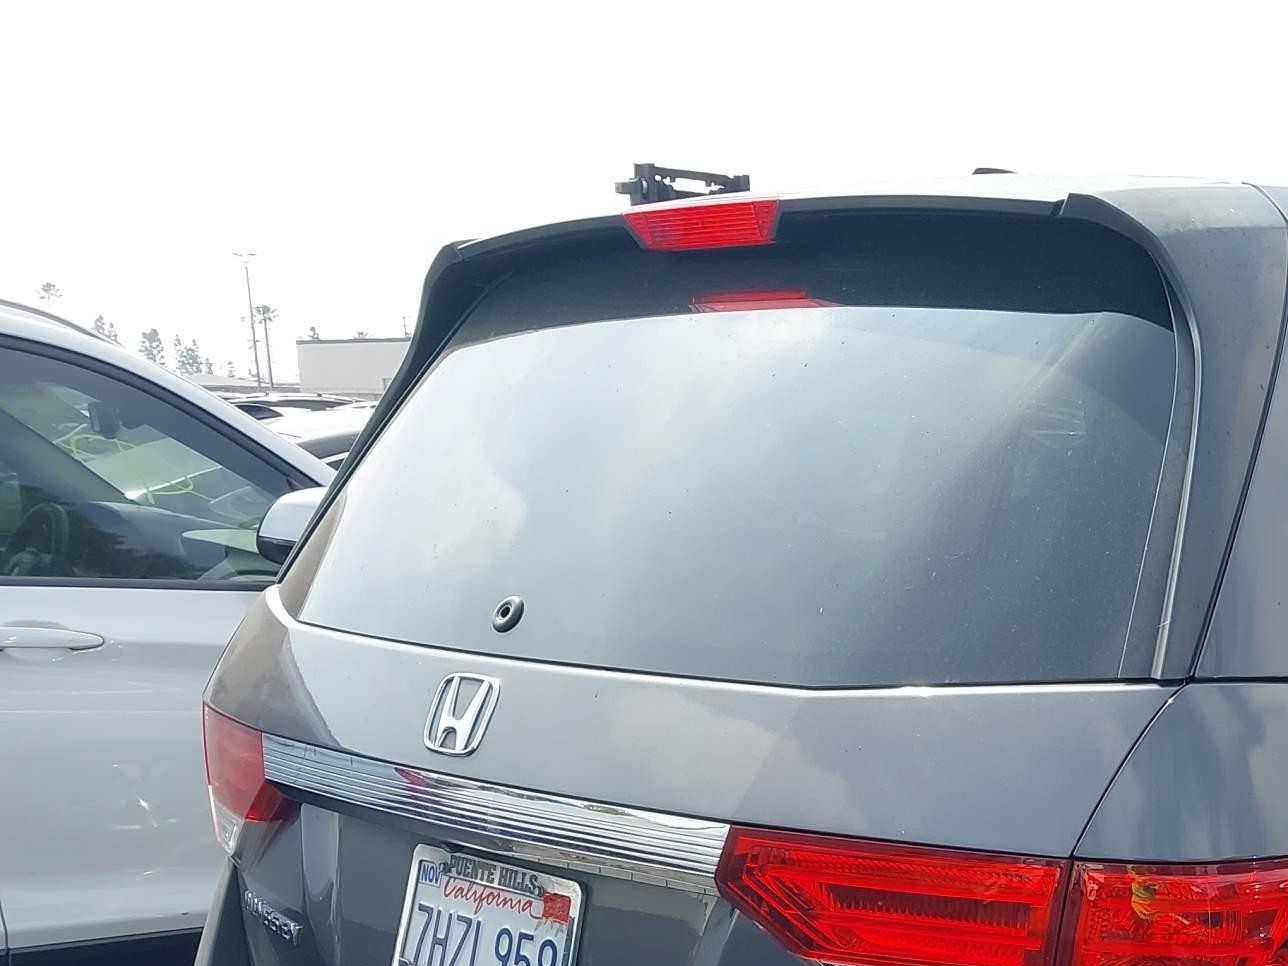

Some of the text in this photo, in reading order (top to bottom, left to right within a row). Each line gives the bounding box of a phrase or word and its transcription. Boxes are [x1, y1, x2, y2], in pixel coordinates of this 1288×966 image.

[421, 863, 440, 885] NOV
[448, 854, 543, 897] PUENTE HILLS
[443, 876, 542, 918] California
